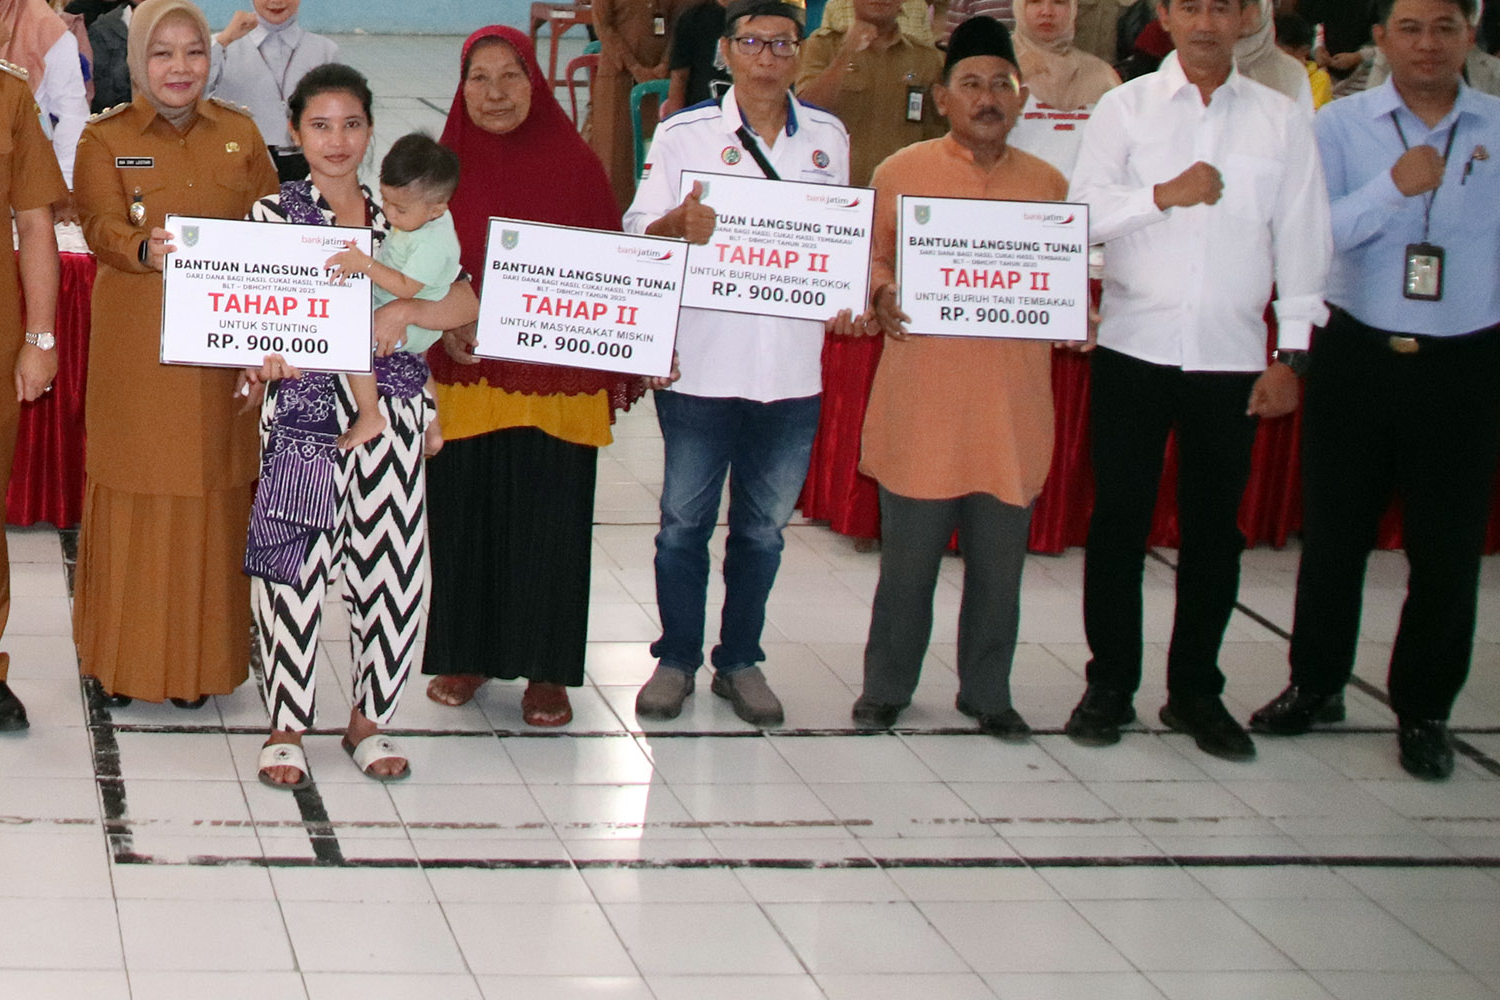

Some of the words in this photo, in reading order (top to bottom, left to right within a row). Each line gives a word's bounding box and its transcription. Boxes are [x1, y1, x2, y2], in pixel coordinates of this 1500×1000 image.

[750, 217, 821, 233] LANGSUNG
[826, 224, 865, 238] TUNAI
[618, 246, 661, 257] bankjatim
[909, 236, 968, 248] BANTUAN
[972, 240, 1040, 252] LANGSUNG
[1044, 243, 1082, 253] TUNAI
[175, 259, 239, 272] BANTUAN
[244, 263, 318, 277] LANGSUNG
[715, 244, 799, 268] TAHAP
[808, 254, 830, 272] II
[492, 260, 555, 276] BANTUAN
[560, 268, 632, 286] LANGSUNG
[636, 278, 676, 290] TUNAI
[690, 266, 726, 278] UNTUK
[730, 270, 766, 281] BURUH
[770, 274, 809, 284] PABRIK
[812, 278, 850, 290] ROKOK
[940, 268, 1022, 290] TAHAP
[1030, 272, 1050, 290] II
[627, 289, 662, 298] TEMBAKAU
[712, 282, 742, 298] RP.
[749, 285, 826, 306] 900.000
[916, 292, 950, 302] UNTUK
[953, 294, 990, 303] BURUH
[993, 295, 1015, 305] TANI
[1018, 296, 1075, 306] TEMBAKAU
[208, 293, 298, 316] TAHAP
[308, 298, 330, 318] II
[522, 294, 608, 320] TAHAP
[616, 306, 638, 326] II
[940, 306, 969, 322] RP.
[976, 308, 1050, 325] 900.000
[219, 320, 258, 330] UNTUK
[262, 322, 318, 334] STUNTING
[500, 316, 536, 328] UNTUK
[540, 322, 615, 338] MASYARAKAT
[616, 330, 654, 342] MISKIN
[207, 333, 239, 349] RP.
[247, 336, 329, 354] 900.000
[518, 332, 548, 349] RP.
[555, 336, 633, 358] 900.000
